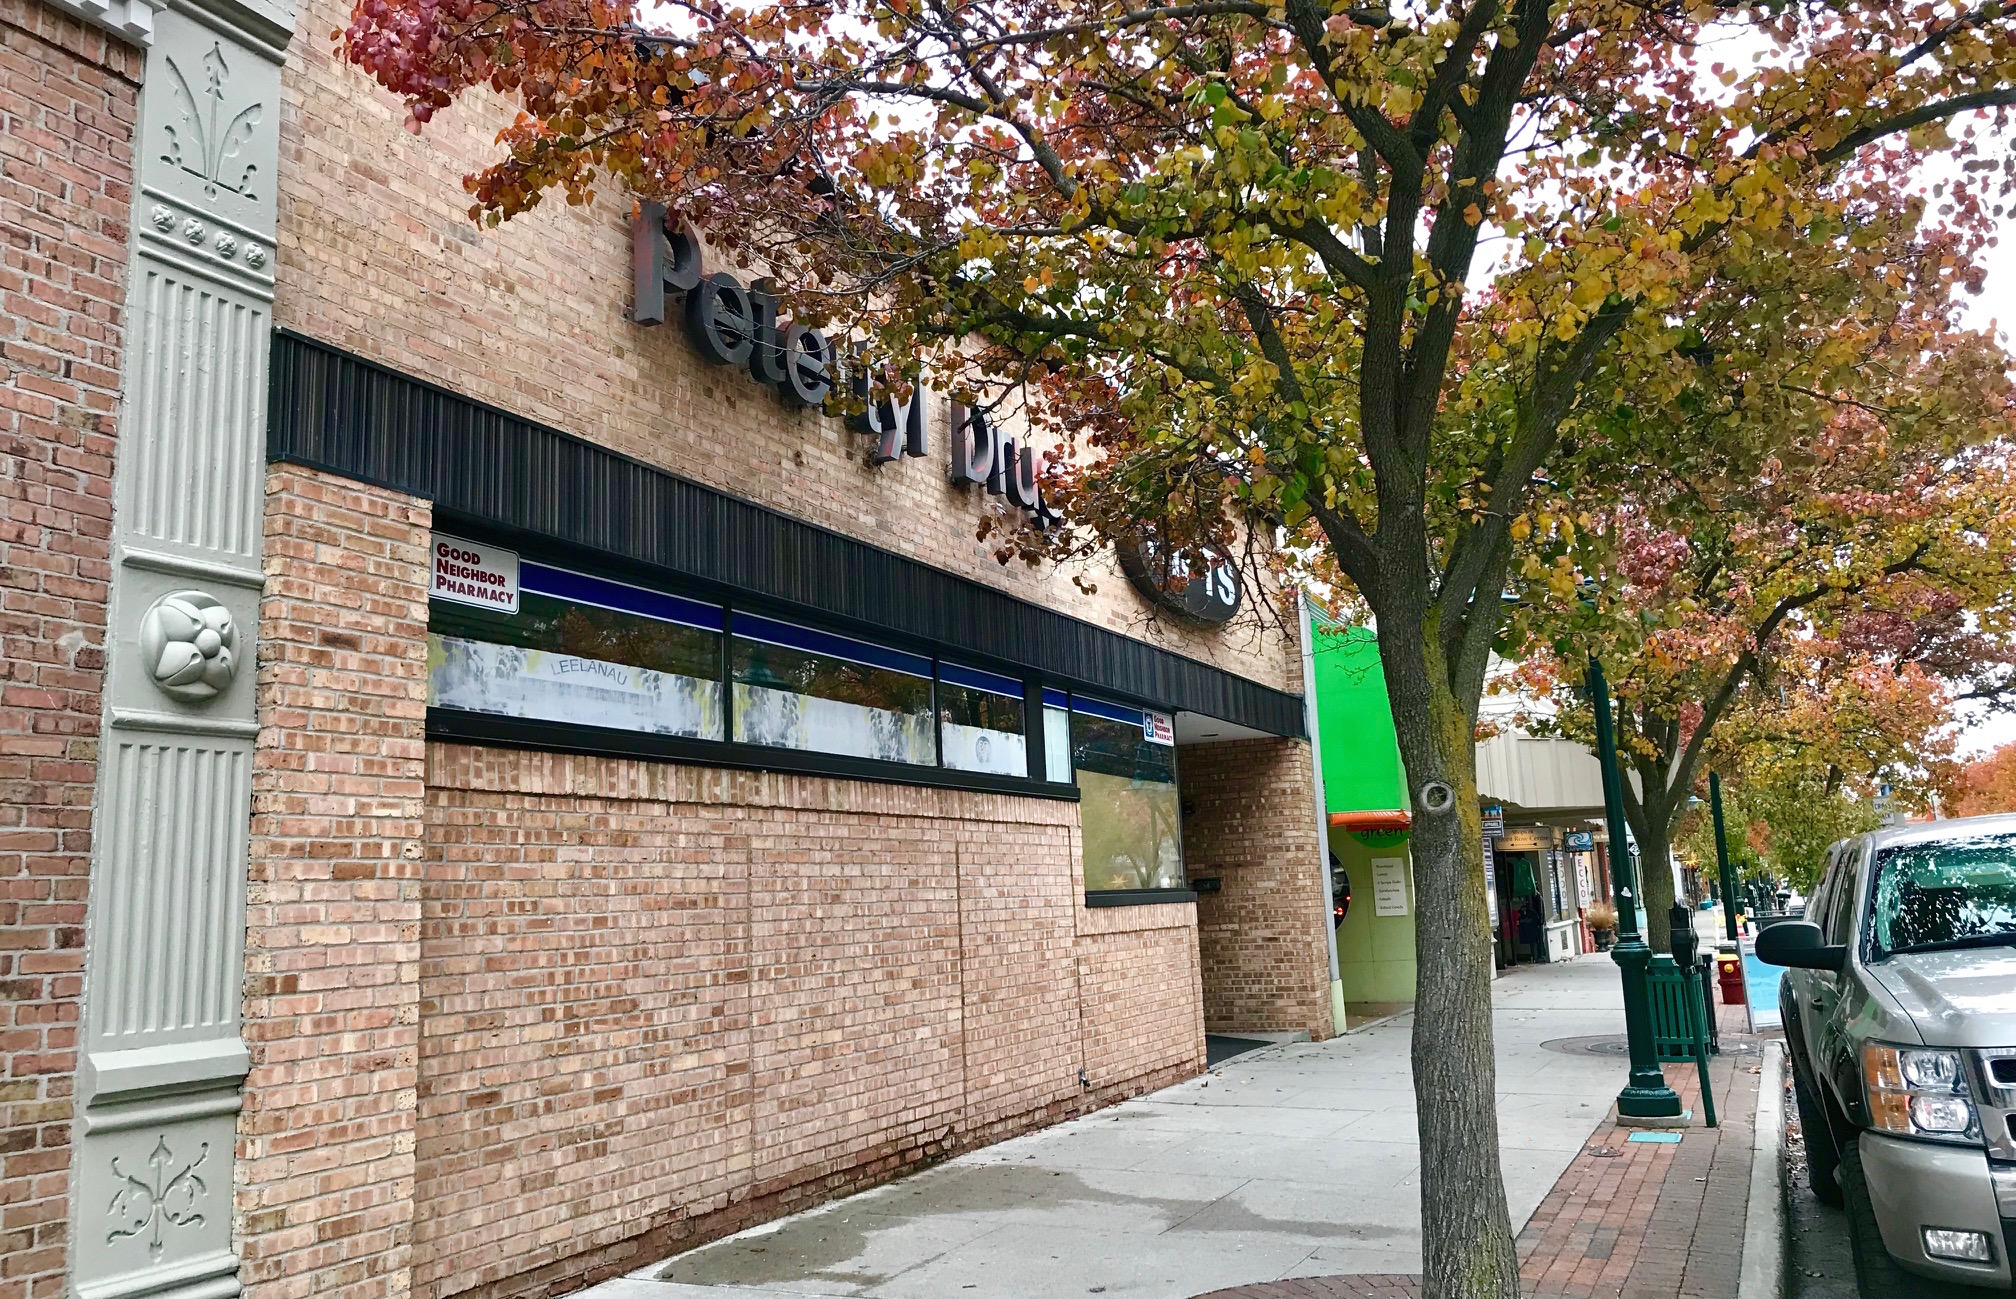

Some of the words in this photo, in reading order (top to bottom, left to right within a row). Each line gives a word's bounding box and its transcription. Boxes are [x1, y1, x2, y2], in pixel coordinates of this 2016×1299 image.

[436, 542, 481, 566] GOOD
[436, 557, 506, 588] NEIGHBOR
[436, 574, 515, 605] PHARMACY
[551, 658, 628, 686] LEELANAU
[1361, 827, 1403, 841] green
[1577, 859, 1587, 898] ECCO
